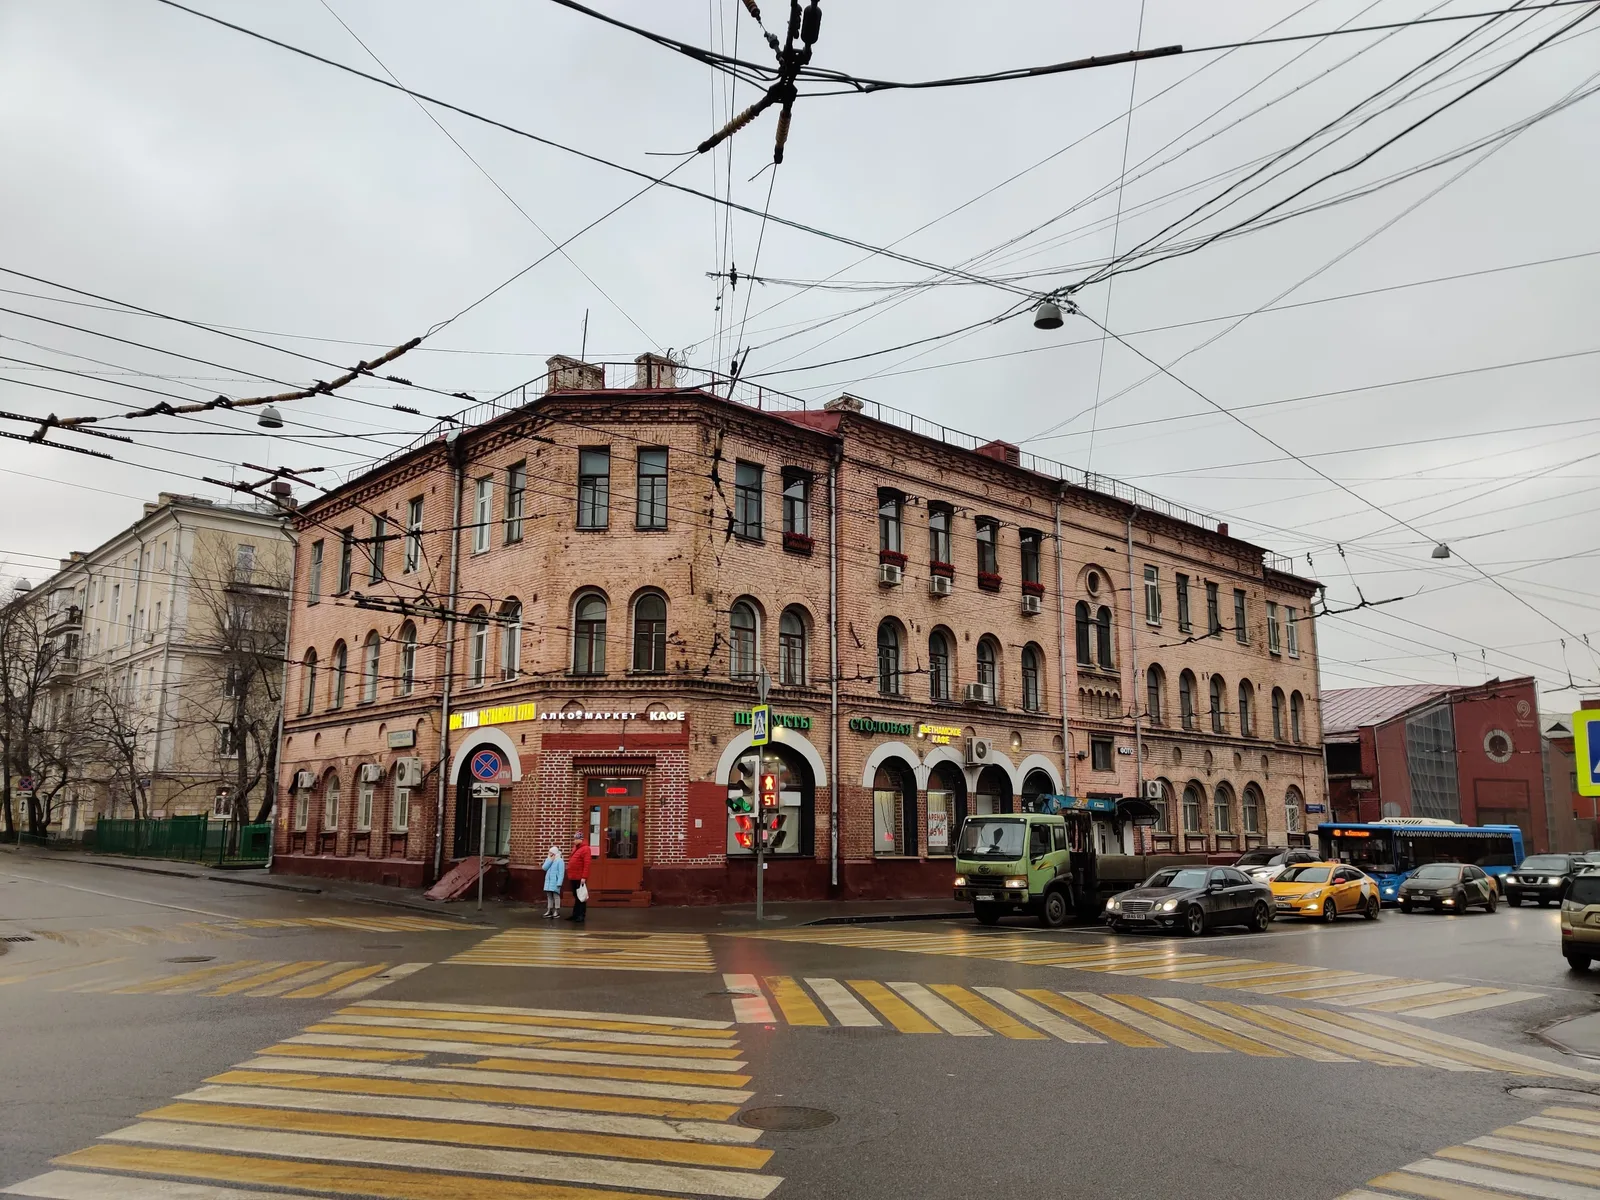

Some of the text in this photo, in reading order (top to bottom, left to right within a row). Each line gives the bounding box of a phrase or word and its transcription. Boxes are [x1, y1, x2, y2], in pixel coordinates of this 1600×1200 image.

[649, 711, 685, 721] КАФЕ
[735, 712, 813, 729] ПРУКТЫ
[849, 718, 912, 735] СТОЛОВАЯ
[919, 724, 962, 737] ВЬЕТНАМСКОЕ
[932, 735, 950, 745] КАФЕ
[1119, 747, 1134, 755] ФОТО
[764, 794, 776, 806] 57
